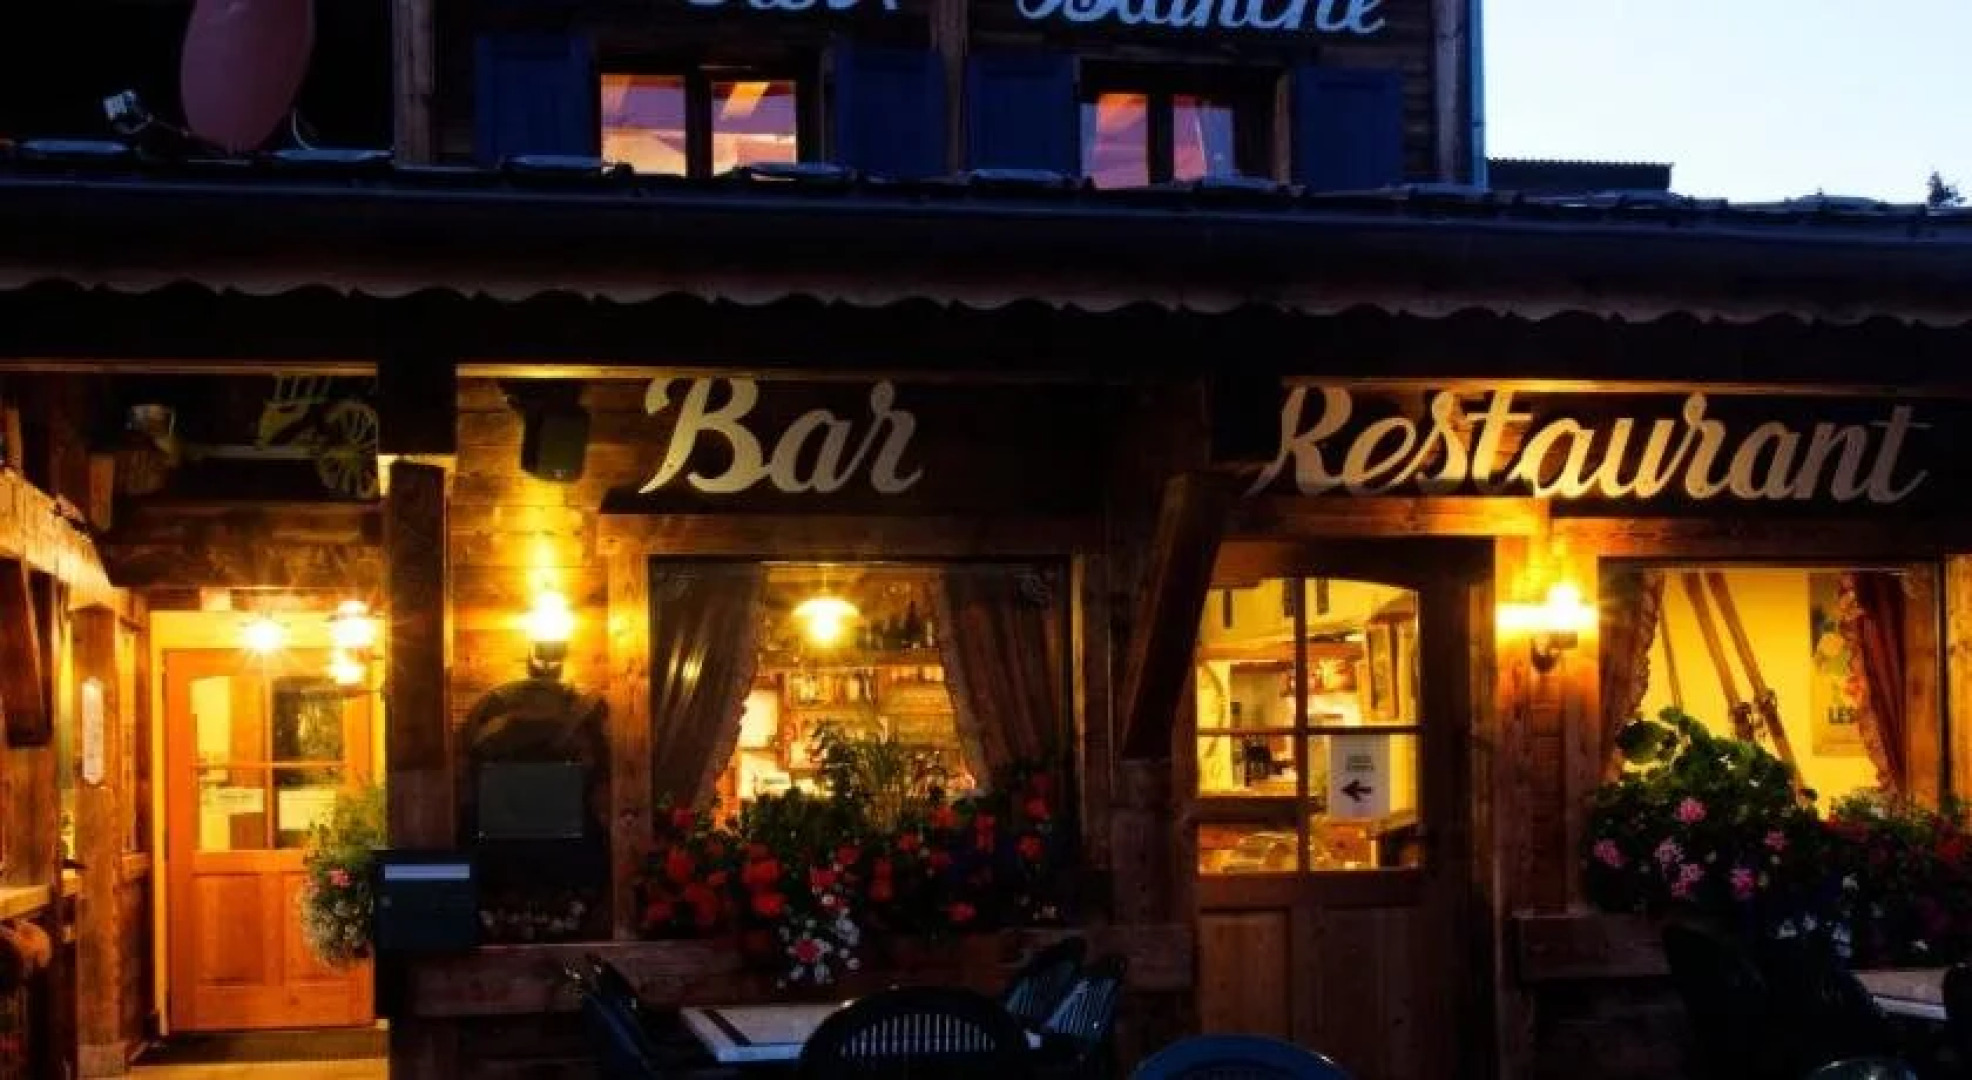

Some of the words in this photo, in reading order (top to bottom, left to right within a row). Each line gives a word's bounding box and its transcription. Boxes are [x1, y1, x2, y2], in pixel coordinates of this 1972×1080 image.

[1016, 0, 1385, 34] ance
[638, 376, 924, 494] Bar
[1245, 384, 1933, 504] Restaurant
